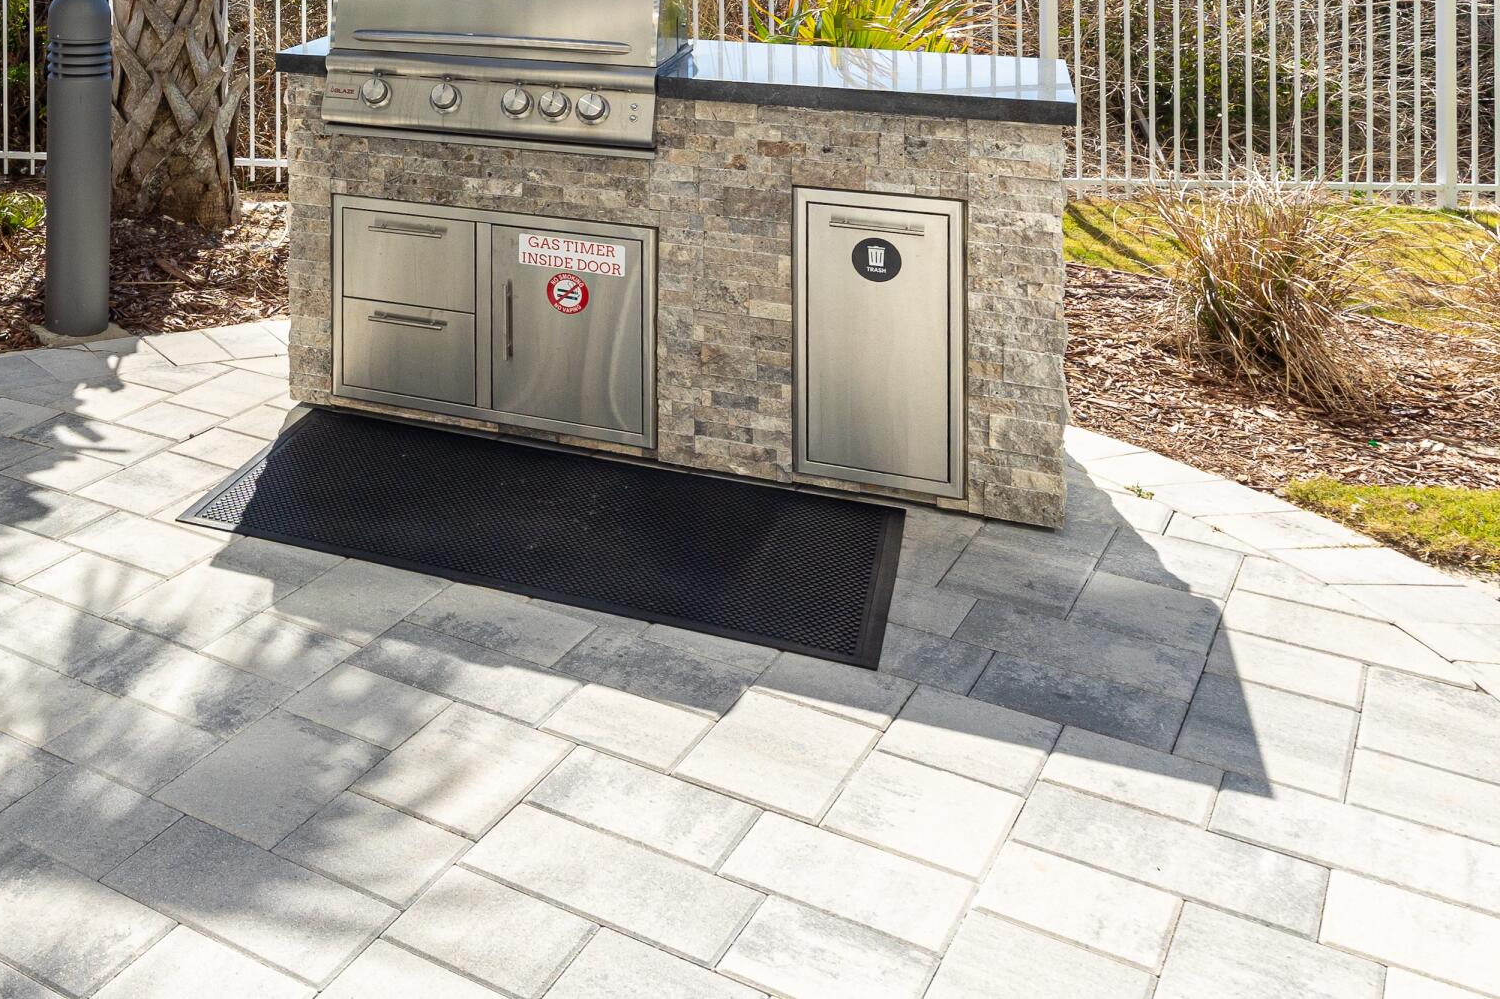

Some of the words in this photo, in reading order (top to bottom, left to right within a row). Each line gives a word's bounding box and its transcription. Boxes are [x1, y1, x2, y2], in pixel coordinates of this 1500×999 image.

[528, 236, 560, 250] GAS
[563, 240, 616, 258] TIMER
[522, 252, 573, 269] INSIDE
[577, 258, 621, 275] DOOR
